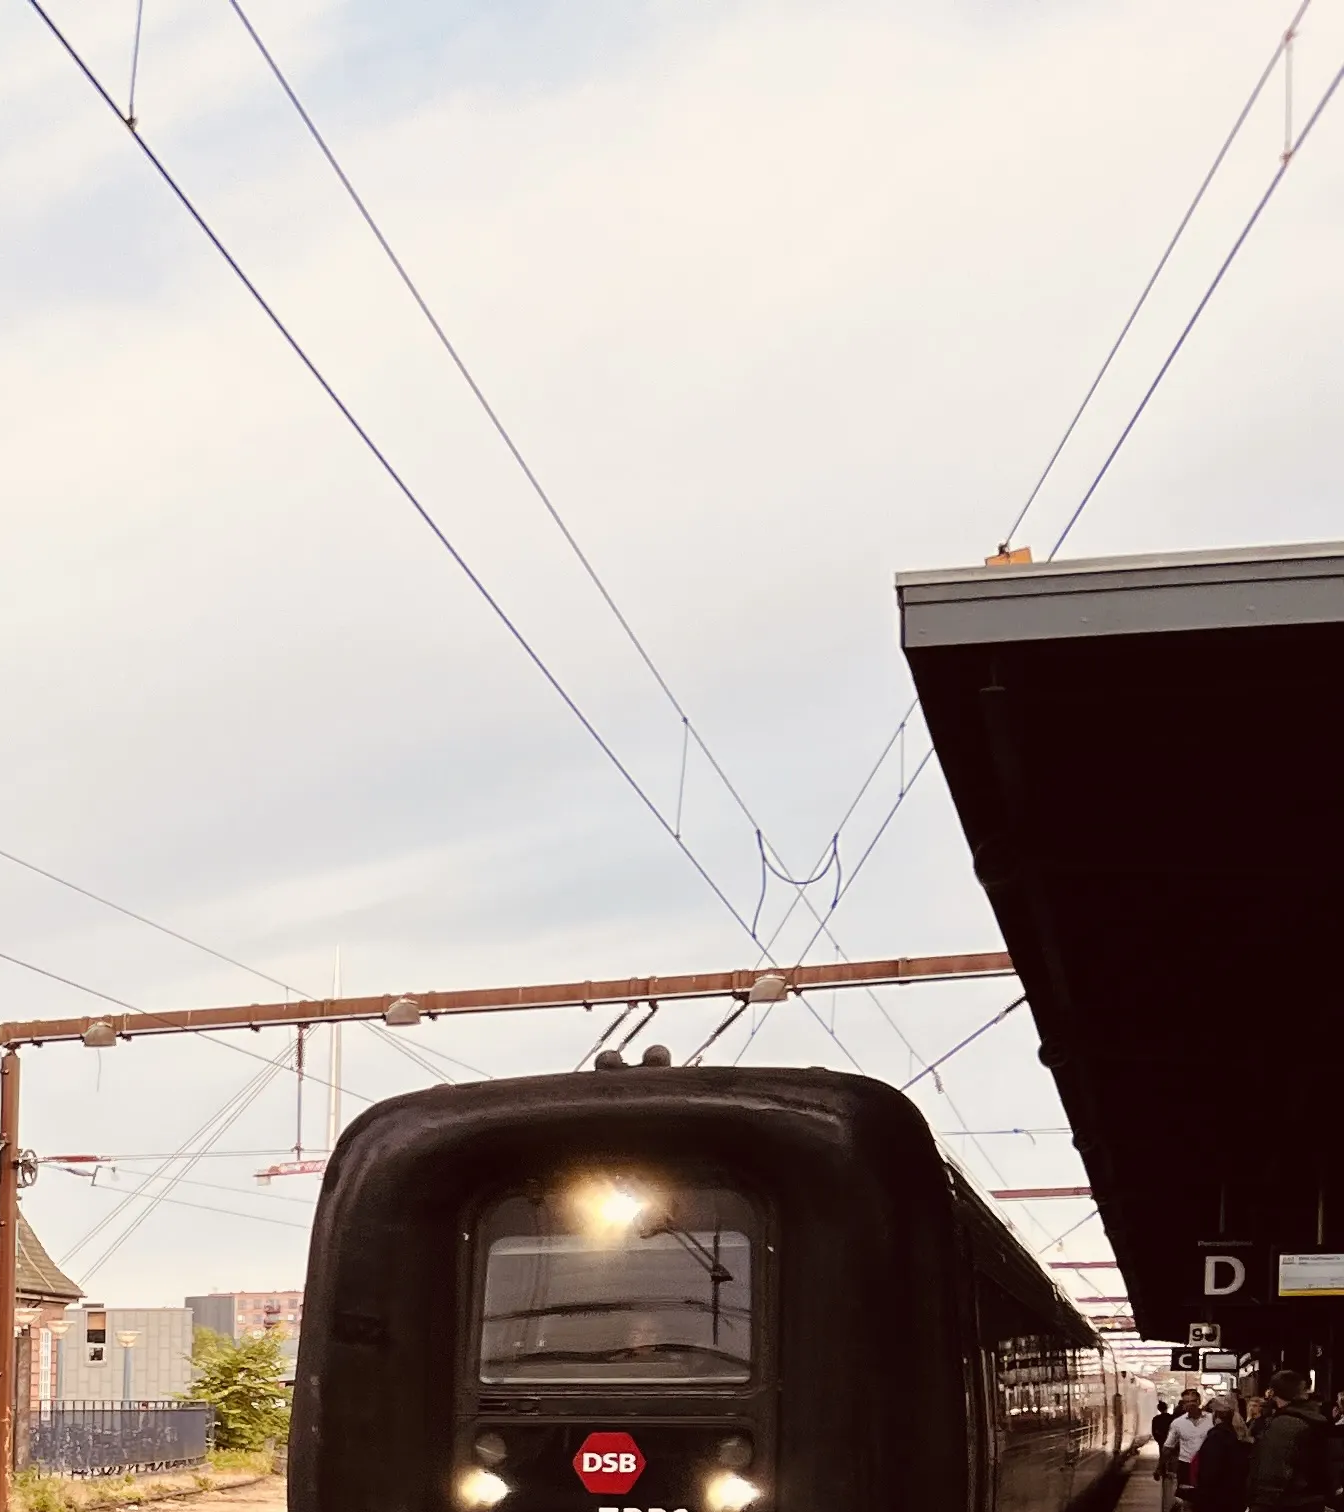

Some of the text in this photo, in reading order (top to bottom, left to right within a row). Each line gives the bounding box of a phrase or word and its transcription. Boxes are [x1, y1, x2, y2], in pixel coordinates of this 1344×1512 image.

[1204, 1255, 1246, 1296] D
[1178, 1353, 1193, 1369] C
[582, 1452, 637, 1473] DSB
